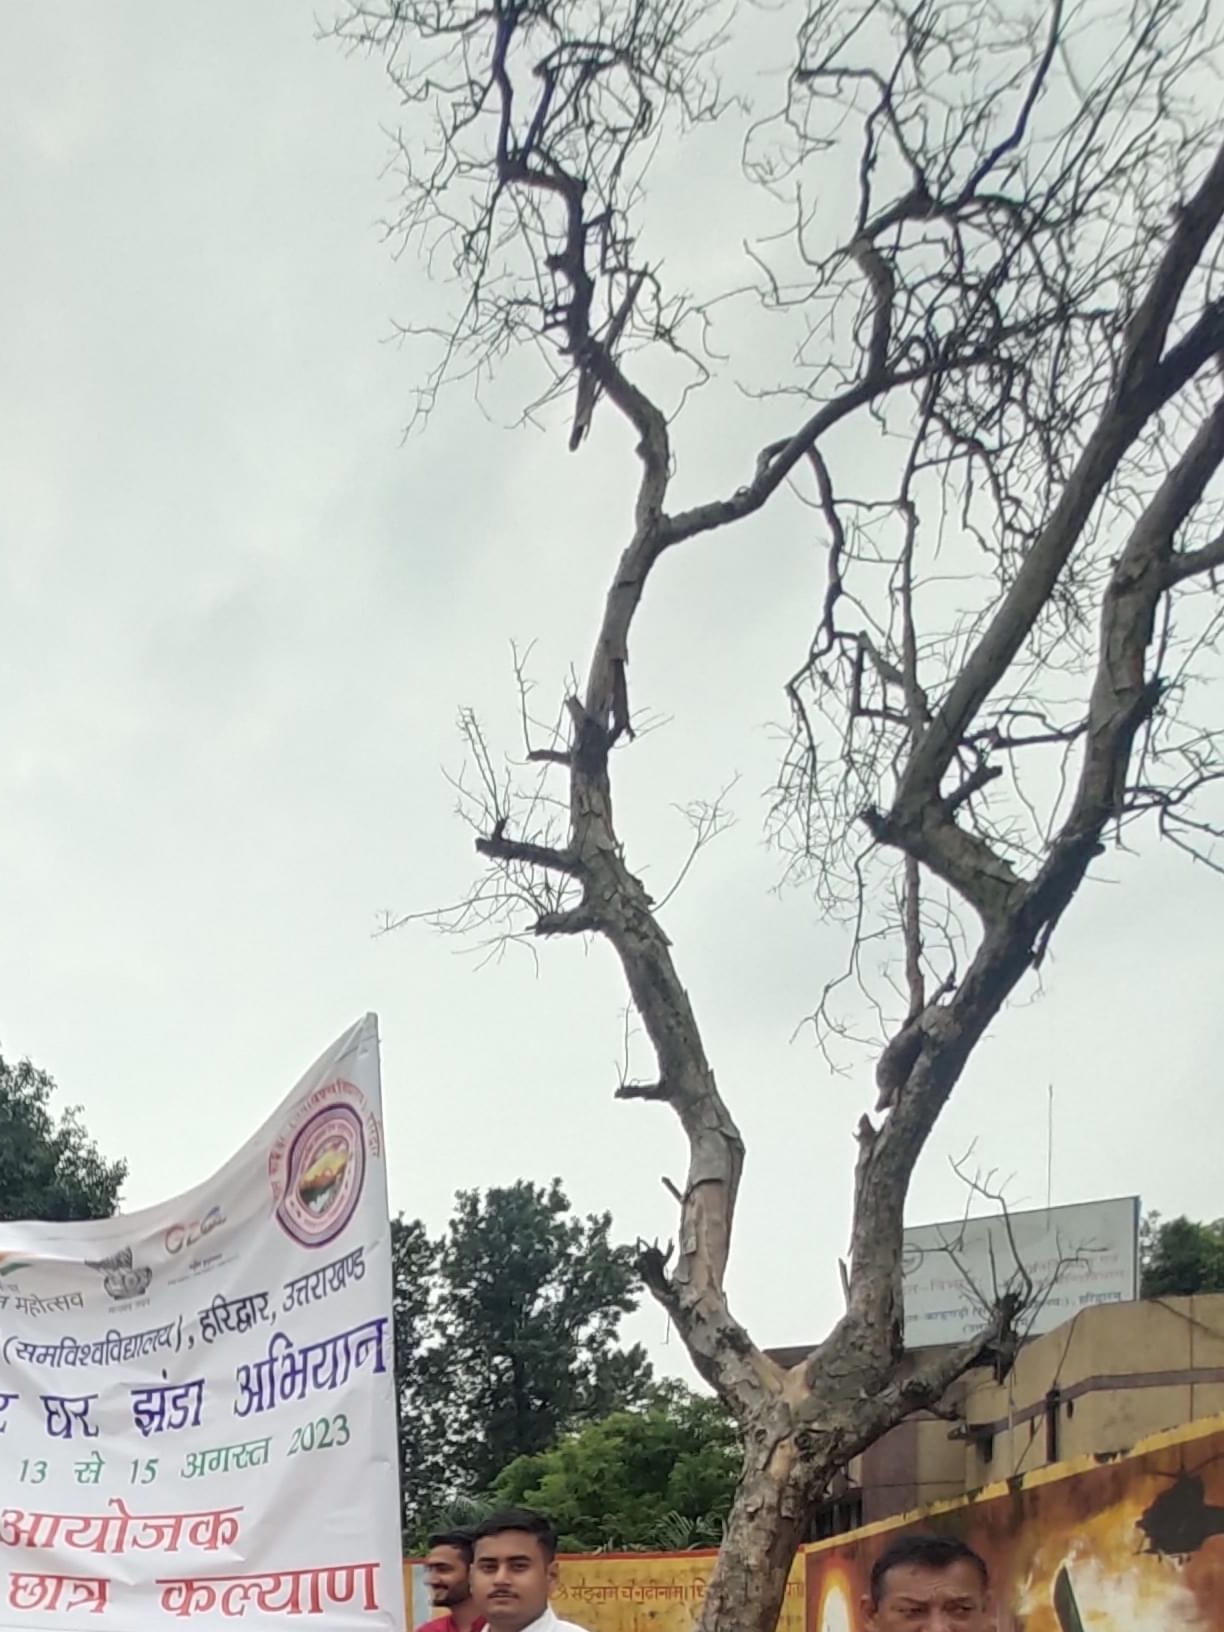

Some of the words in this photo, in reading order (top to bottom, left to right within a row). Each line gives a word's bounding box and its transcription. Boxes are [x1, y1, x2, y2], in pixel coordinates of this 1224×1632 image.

[15, 1291, 86, 1317] महोत्सव
[198, 1291, 276, 1344] हरिद्वार,
[283, 1246, 366, 1313] उत्तराखण्ड
[40, 1394, 100, 1439] घर
[130, 1368, 205, 1436] झंडा
[234, 1317, 388, 1418] अभियान
[19, 1459, 47, 1484] 13
[74, 1451, 104, 1484] से
[130, 1459, 158, 1484] 15
[181, 1437, 272, 1479] अगस्त
[287, 1414, 351, 1456] 2023
[8, 1571, 111, 1614] छात्र
[155, 1562, 380, 1617] कल्याण
